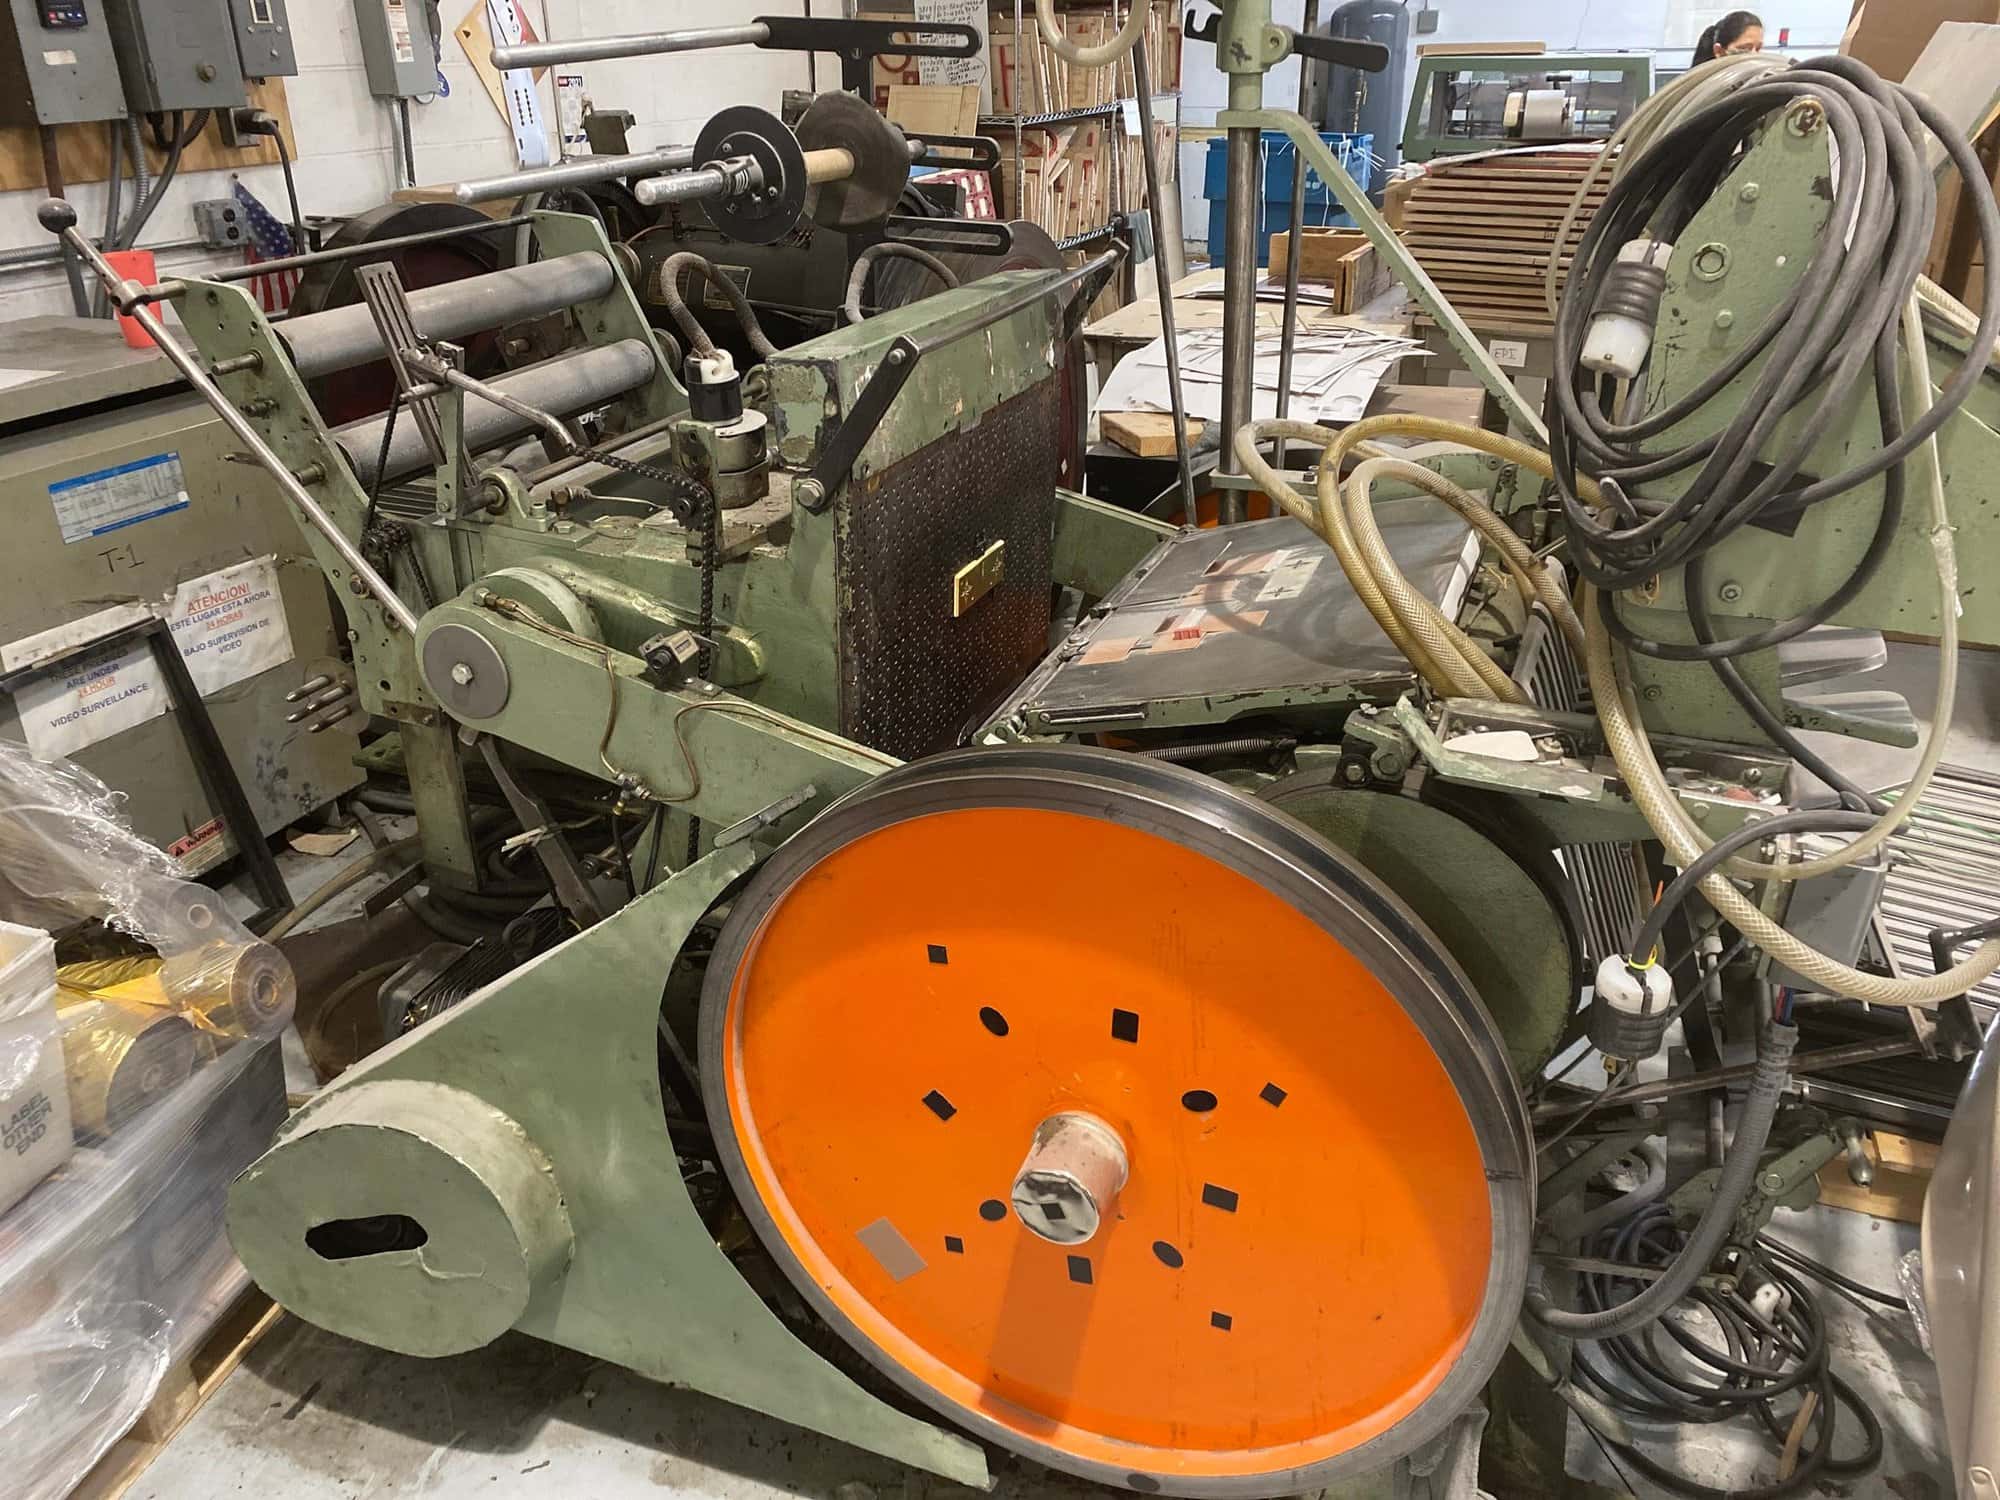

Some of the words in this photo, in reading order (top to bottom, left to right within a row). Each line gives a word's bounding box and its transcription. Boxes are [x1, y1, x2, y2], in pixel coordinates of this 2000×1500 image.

[98, 544, 144, 573] T-1
[169, 616, 191, 632] ESTE
[192, 607, 221, 624] LUGAR
[222, 600, 242, 613] ESTA
[243, 589, 271, 605] AHORA
[183, 642, 207, 657] BAJO
[207, 622, 258, 649] SUPERVISION
[259, 617, 271, 628] DE
[219, 639, 242, 654] VIDEO
[66, 676, 87, 689] ARE
[87, 663, 121, 681] UNDER
[90, 676, 116, 694] HOUR
[50, 710, 81, 728] VIDEO
[81, 682, 149, 715] SURVEILLANCE
[1, 1091, 50, 1136] LABEL
[3, 1102, 52, 1149] OTHER
[15, 1123, 47, 1156] END
